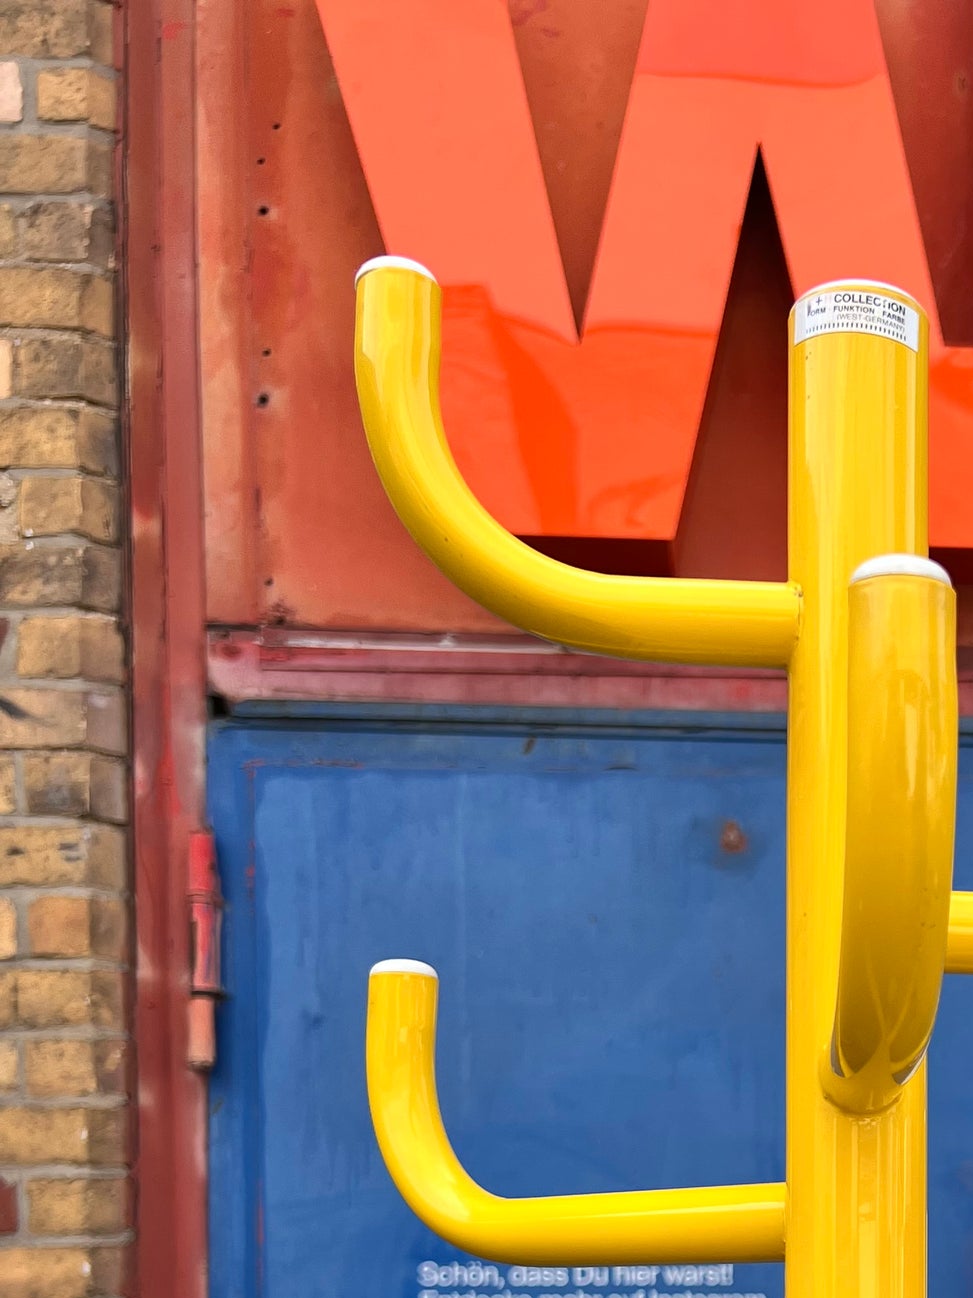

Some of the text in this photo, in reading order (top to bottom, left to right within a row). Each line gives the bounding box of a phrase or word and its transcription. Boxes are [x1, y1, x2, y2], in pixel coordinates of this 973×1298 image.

[833, 305, 875, 315] FUNKTION
[882, 311, 906, 326] FARBE
[416, 1260, 506, 1290] Schön,
[508, 1266, 570, 1287] dass
[572, 1266, 609, 1287] Du
[612, 1266, 661, 1287] hier
